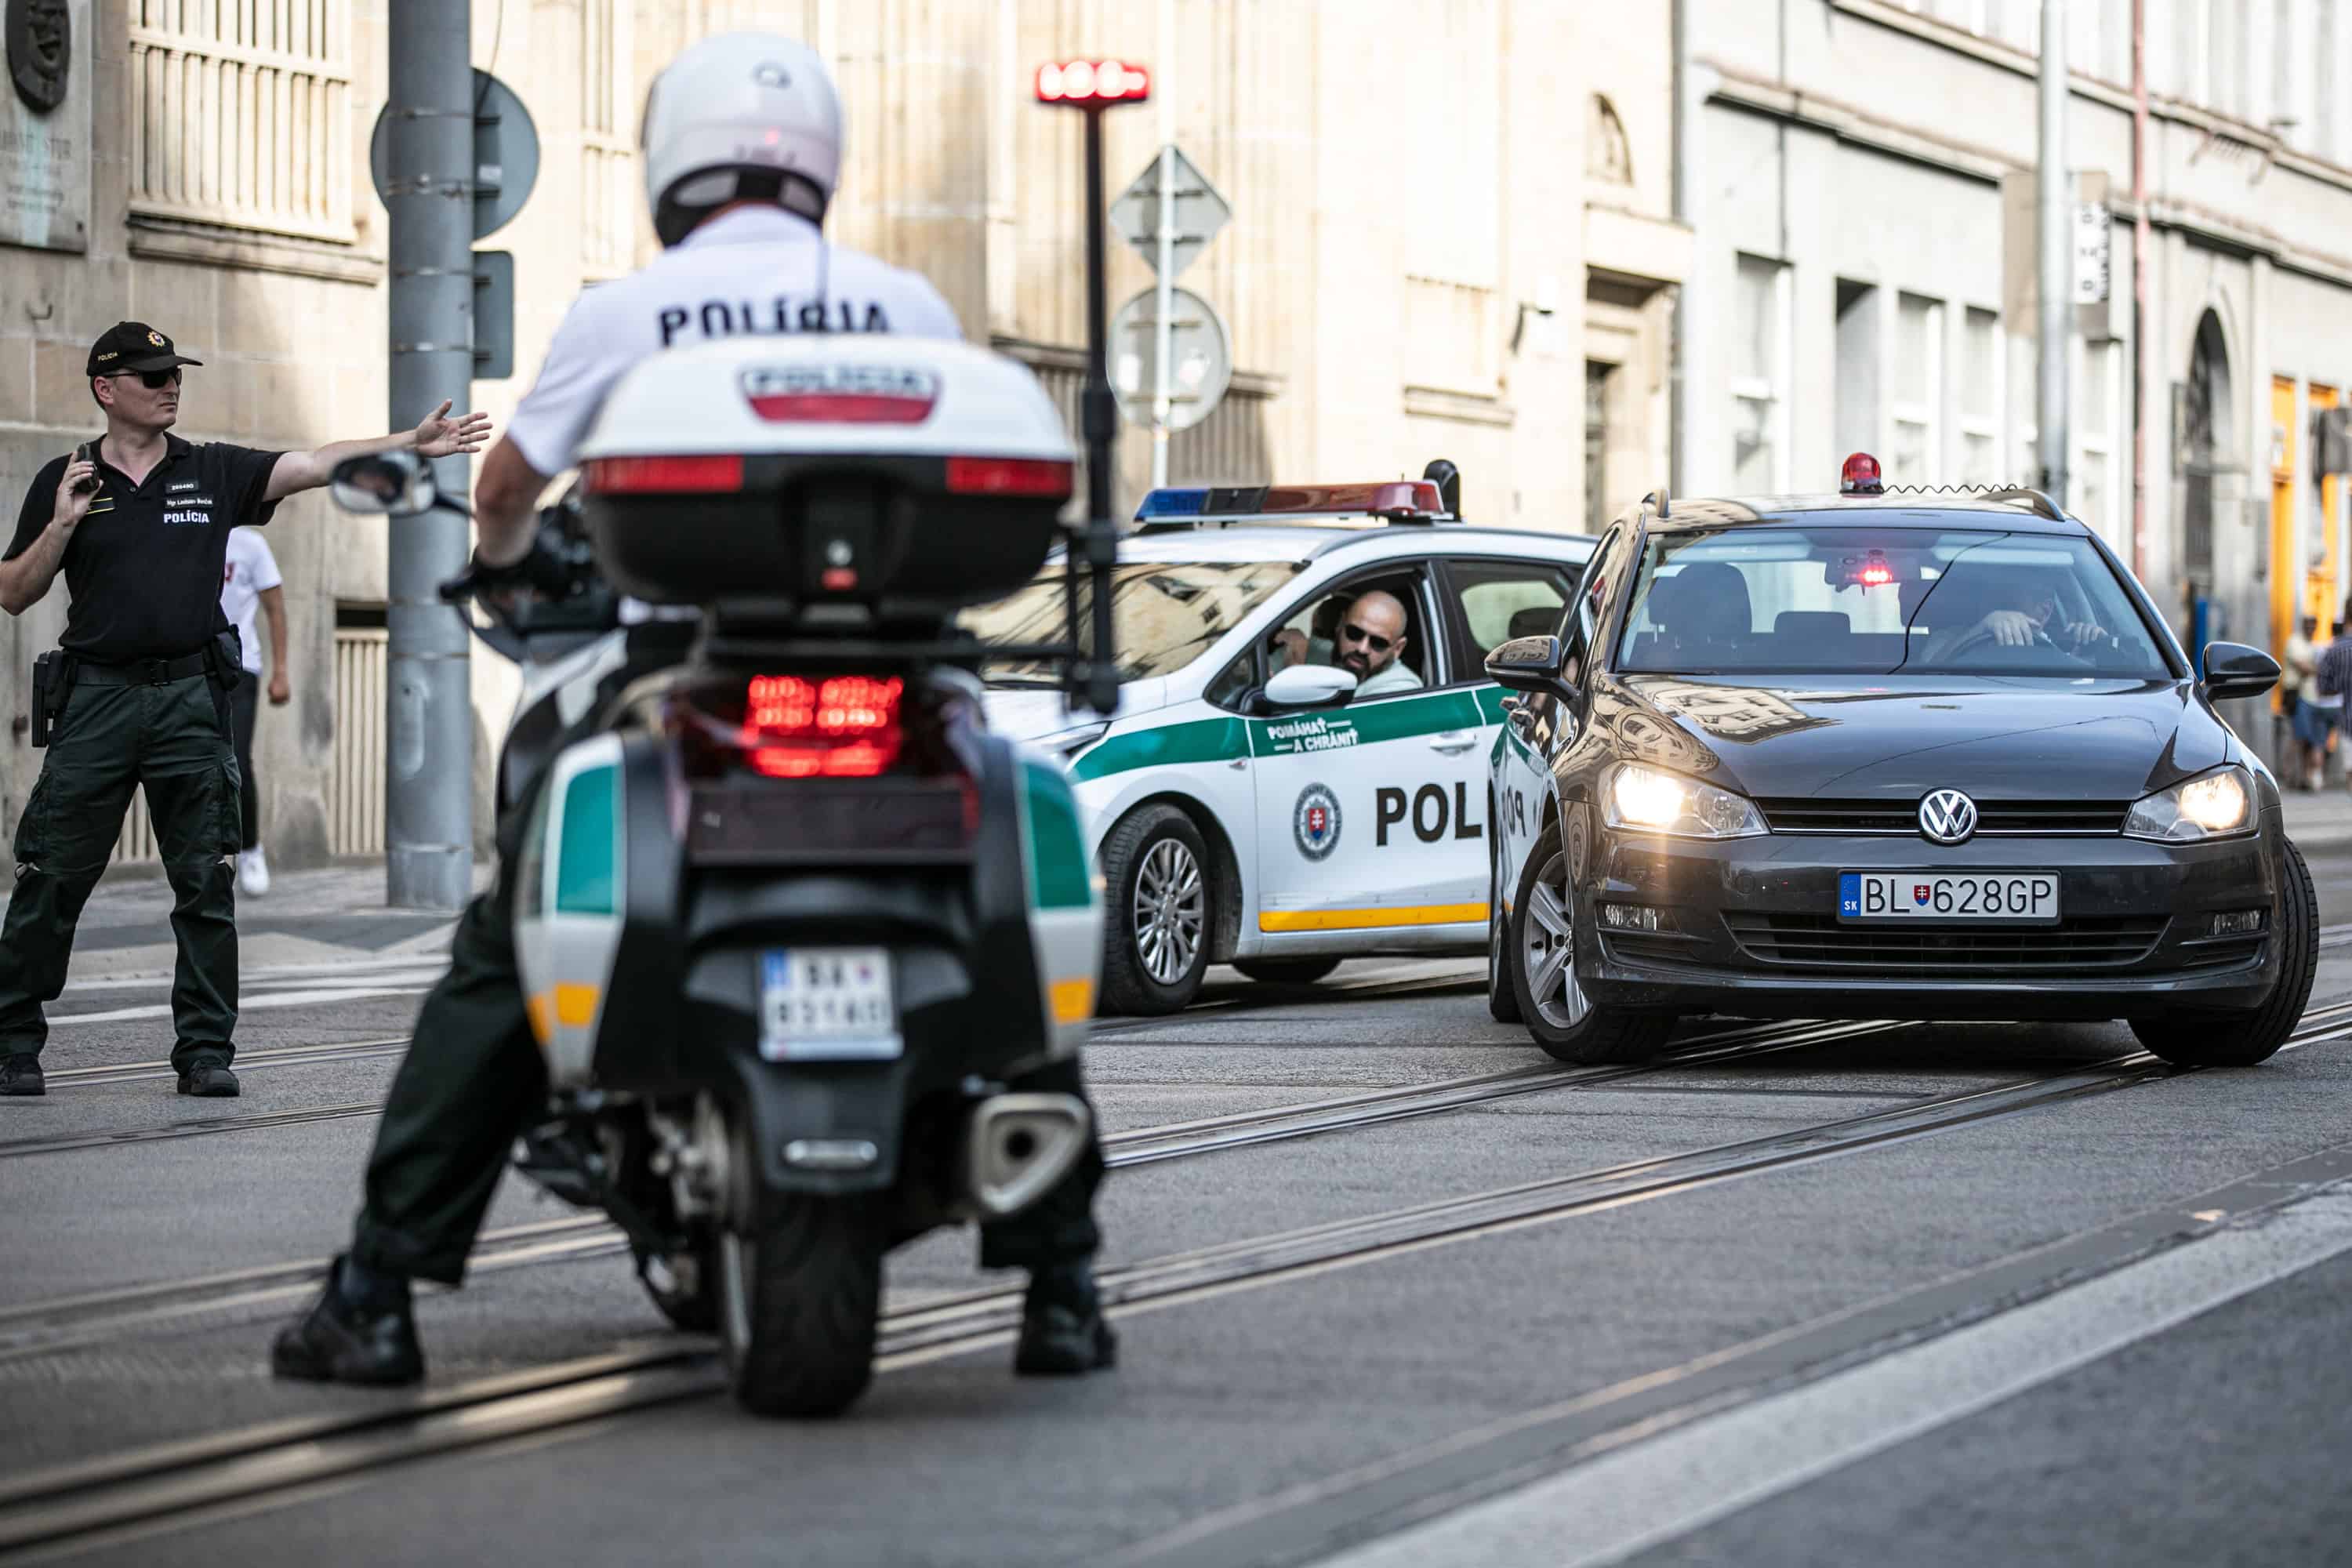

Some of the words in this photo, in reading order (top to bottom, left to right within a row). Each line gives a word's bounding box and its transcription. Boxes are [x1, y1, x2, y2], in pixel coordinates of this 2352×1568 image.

[163, 510, 209, 524] POLÍCIA
[1267, 717, 1327, 740] POMÁHAŤ
[1294, 739, 1303, 753] A
[1304, 728, 1358, 750] CHRÁNIŤ
[1376, 781, 1483, 847] POL
[1844, 901, 1857, 910] SK
[1866, 878, 1910, 913] BL
[1933, 879, 2052, 914] 628GP
